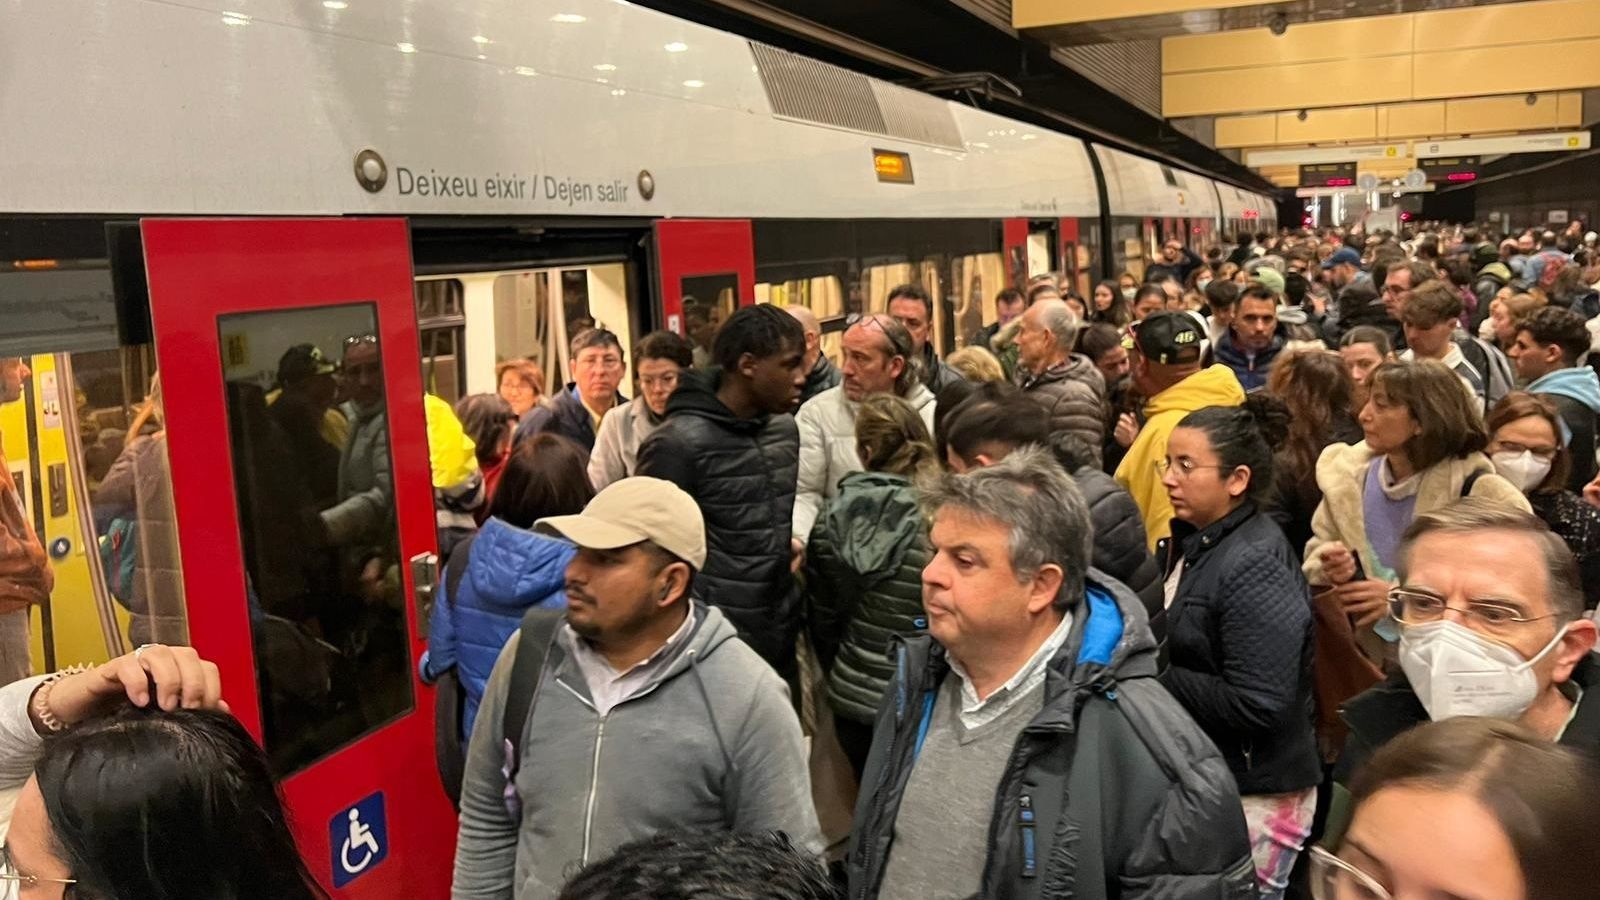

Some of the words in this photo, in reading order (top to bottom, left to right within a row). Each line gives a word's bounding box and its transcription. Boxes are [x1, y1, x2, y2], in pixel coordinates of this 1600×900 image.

[397, 167, 478, 198] Deixeu
[485, 173, 526, 199] eixir
[532, 175, 537, 198] /
[545, 176, 593, 206] Dejen
[598, 180, 628, 202] salir
[1175, 331, 1194, 343] 46
